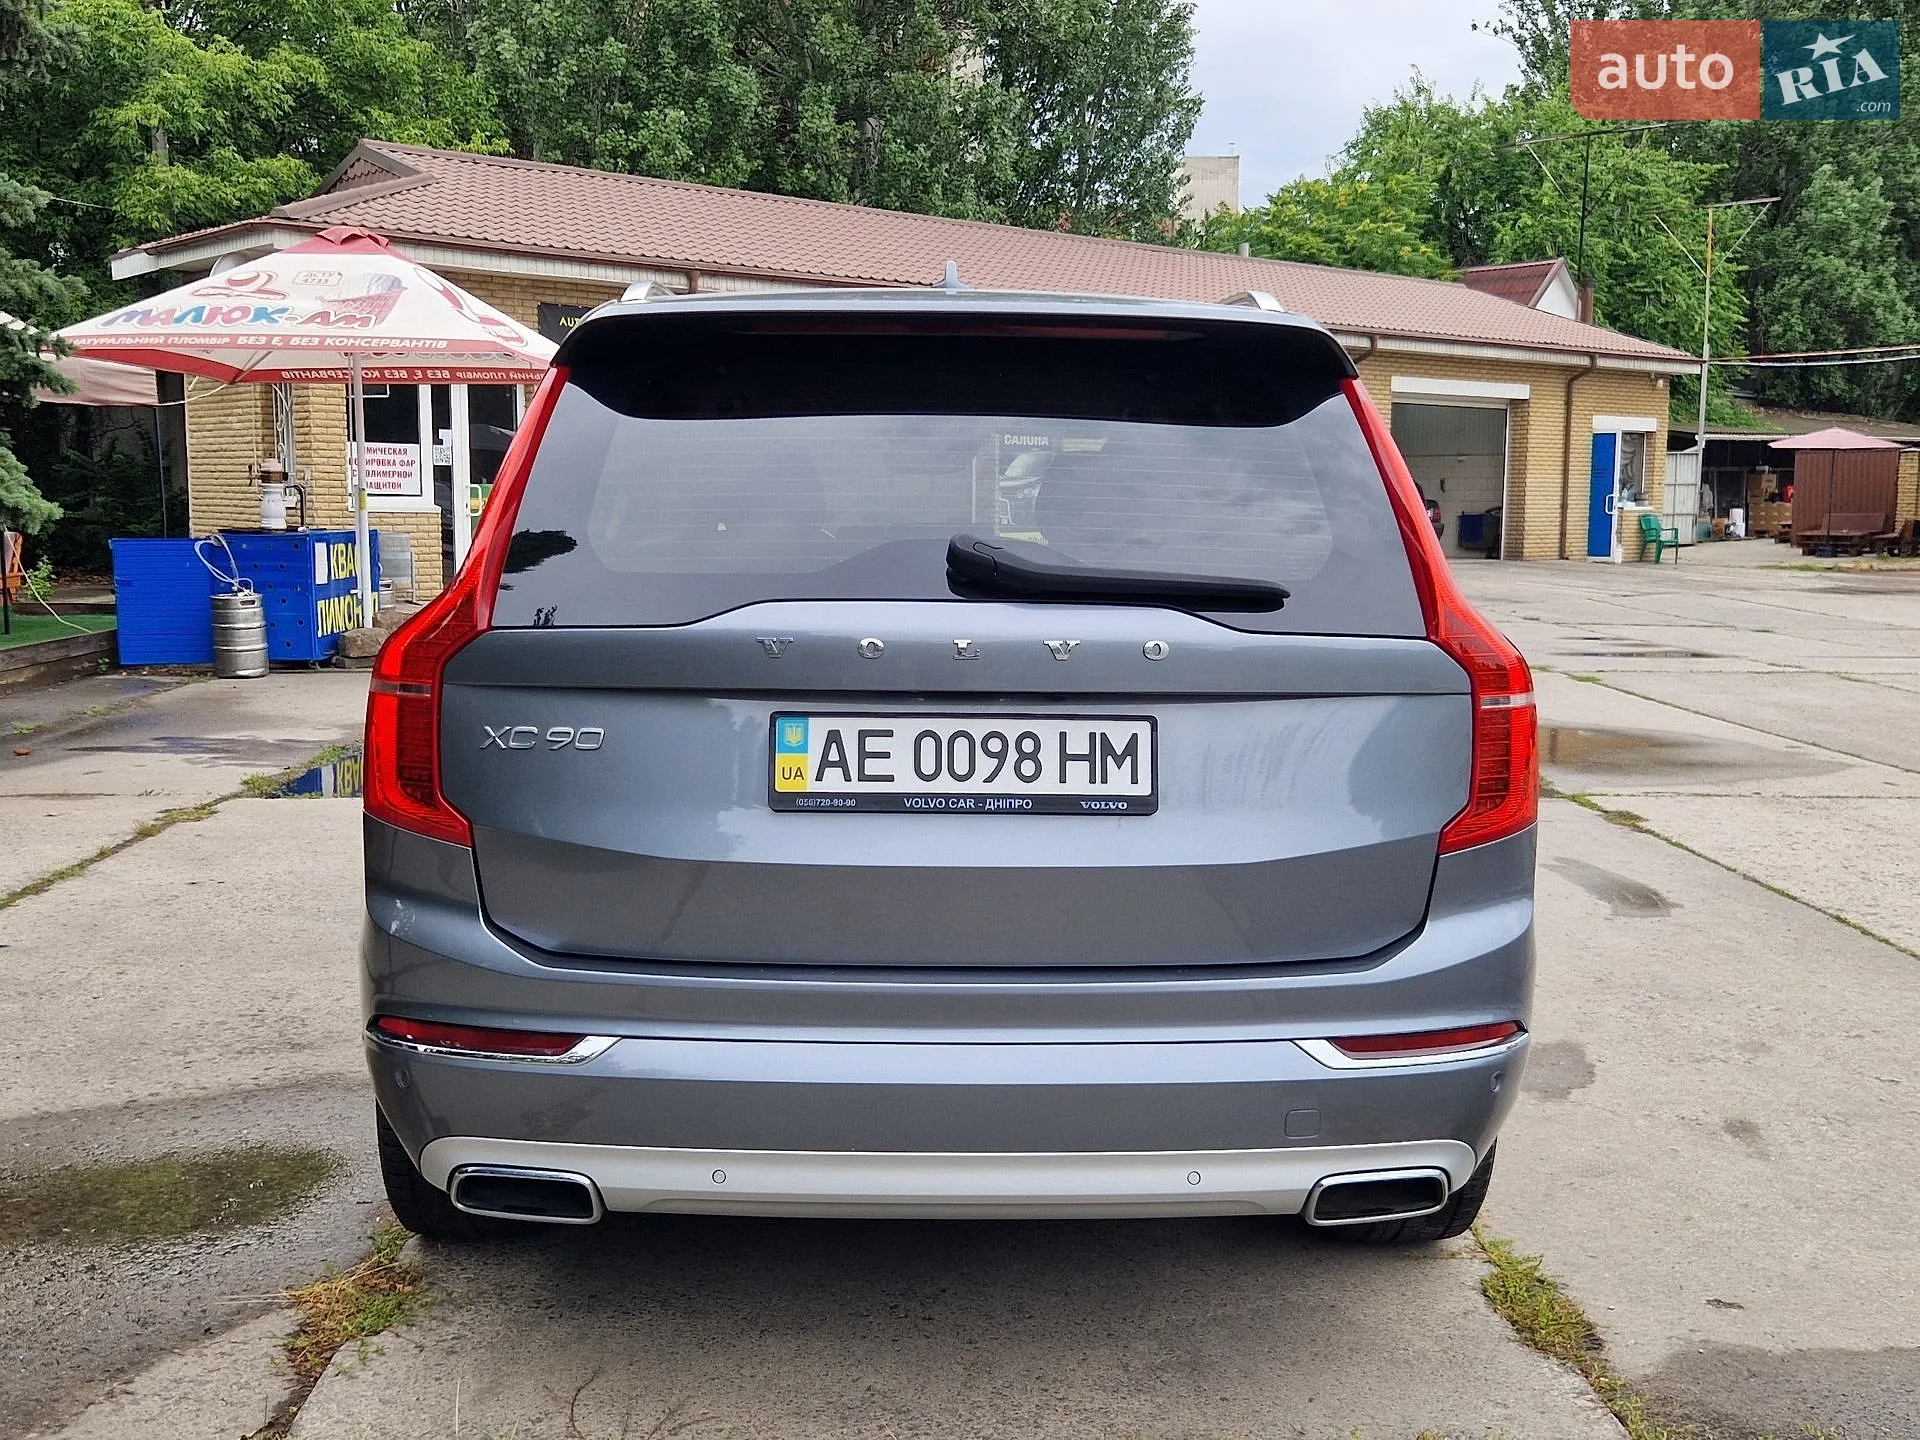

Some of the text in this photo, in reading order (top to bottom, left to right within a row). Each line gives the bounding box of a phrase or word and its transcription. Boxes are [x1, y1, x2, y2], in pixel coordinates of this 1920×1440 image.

[167, 336, 231, 345] ПЛОМБІР
[237, 336, 267, 345] БЕЗ
[289, 337, 319, 346] БЕЗ
[324, 337, 448, 349] КОНСЕРВАНТІВ
[366, 446, 408, 456] МИЧЕСКАЯ
[348, 457, 416, 468] ОИРОВКА ФАР
[365, 469, 413, 479] ОЛИМЕРНОЙ
[756, 636, 1170, 662] VOLVO
[814, 728, 1139, 785] AE 0098 HM
[781, 767, 805, 782] UA
[903, 798, 946, 809] VOLVO
[948, 799, 975, 809] CAR
[1079, 801, 1128, 810] VOLVO
